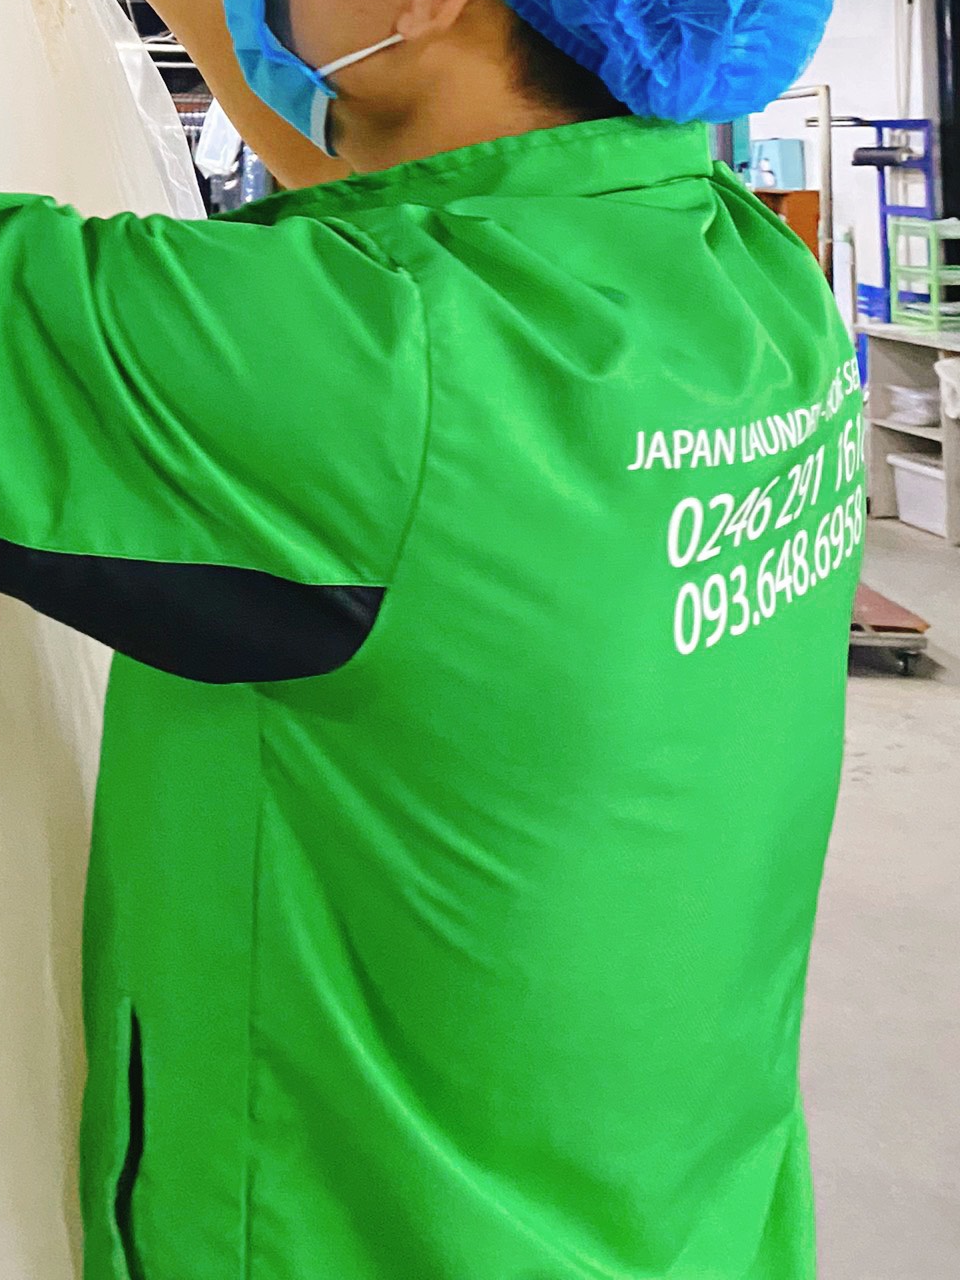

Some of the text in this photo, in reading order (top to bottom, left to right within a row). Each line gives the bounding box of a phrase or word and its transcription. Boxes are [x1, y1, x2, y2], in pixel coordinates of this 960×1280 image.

[627, 427, 736, 471] JAPAN
[667, 412, 865, 568] 0246 291 161
[673, 484, 862, 656] 093.648.6958
